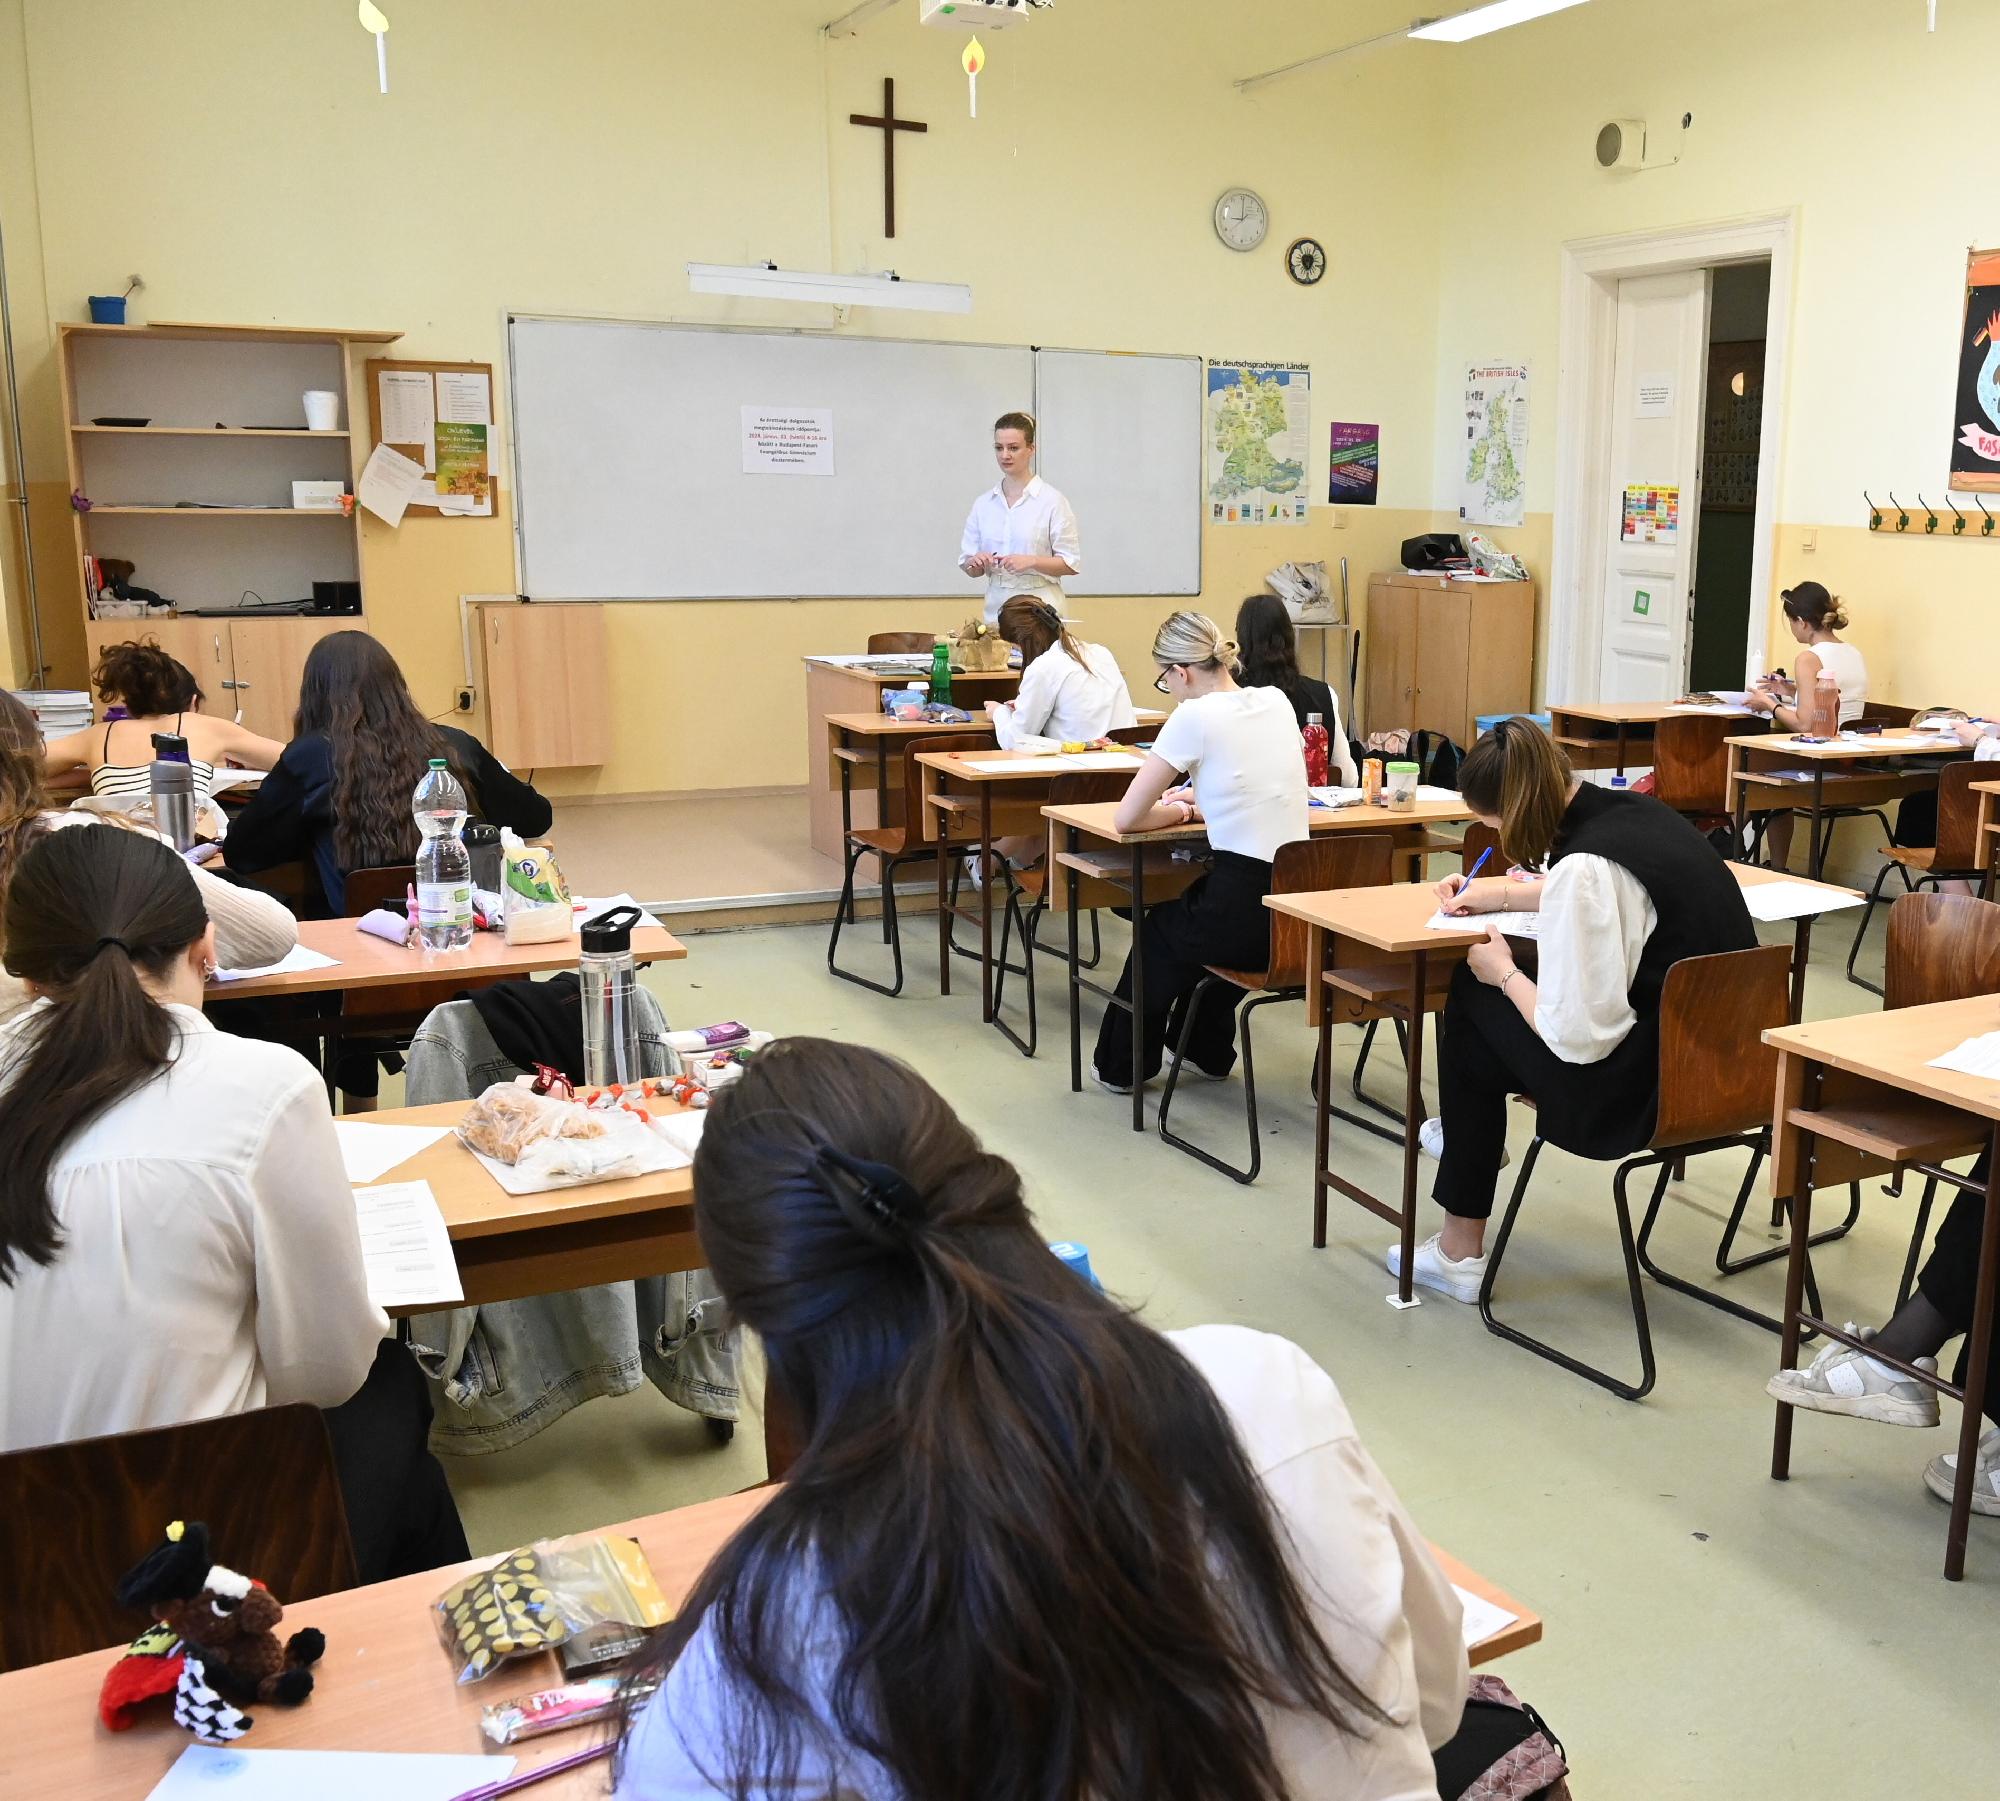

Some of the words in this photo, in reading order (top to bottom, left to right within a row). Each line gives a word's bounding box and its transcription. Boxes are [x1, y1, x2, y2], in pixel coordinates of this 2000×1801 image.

[1208, 358, 1221, 367] Die
[1223, 359, 1285, 371] deutschsprachigen
[1286, 361, 1310, 371] Länder
[1979, 436, 2000, 457] FAS
